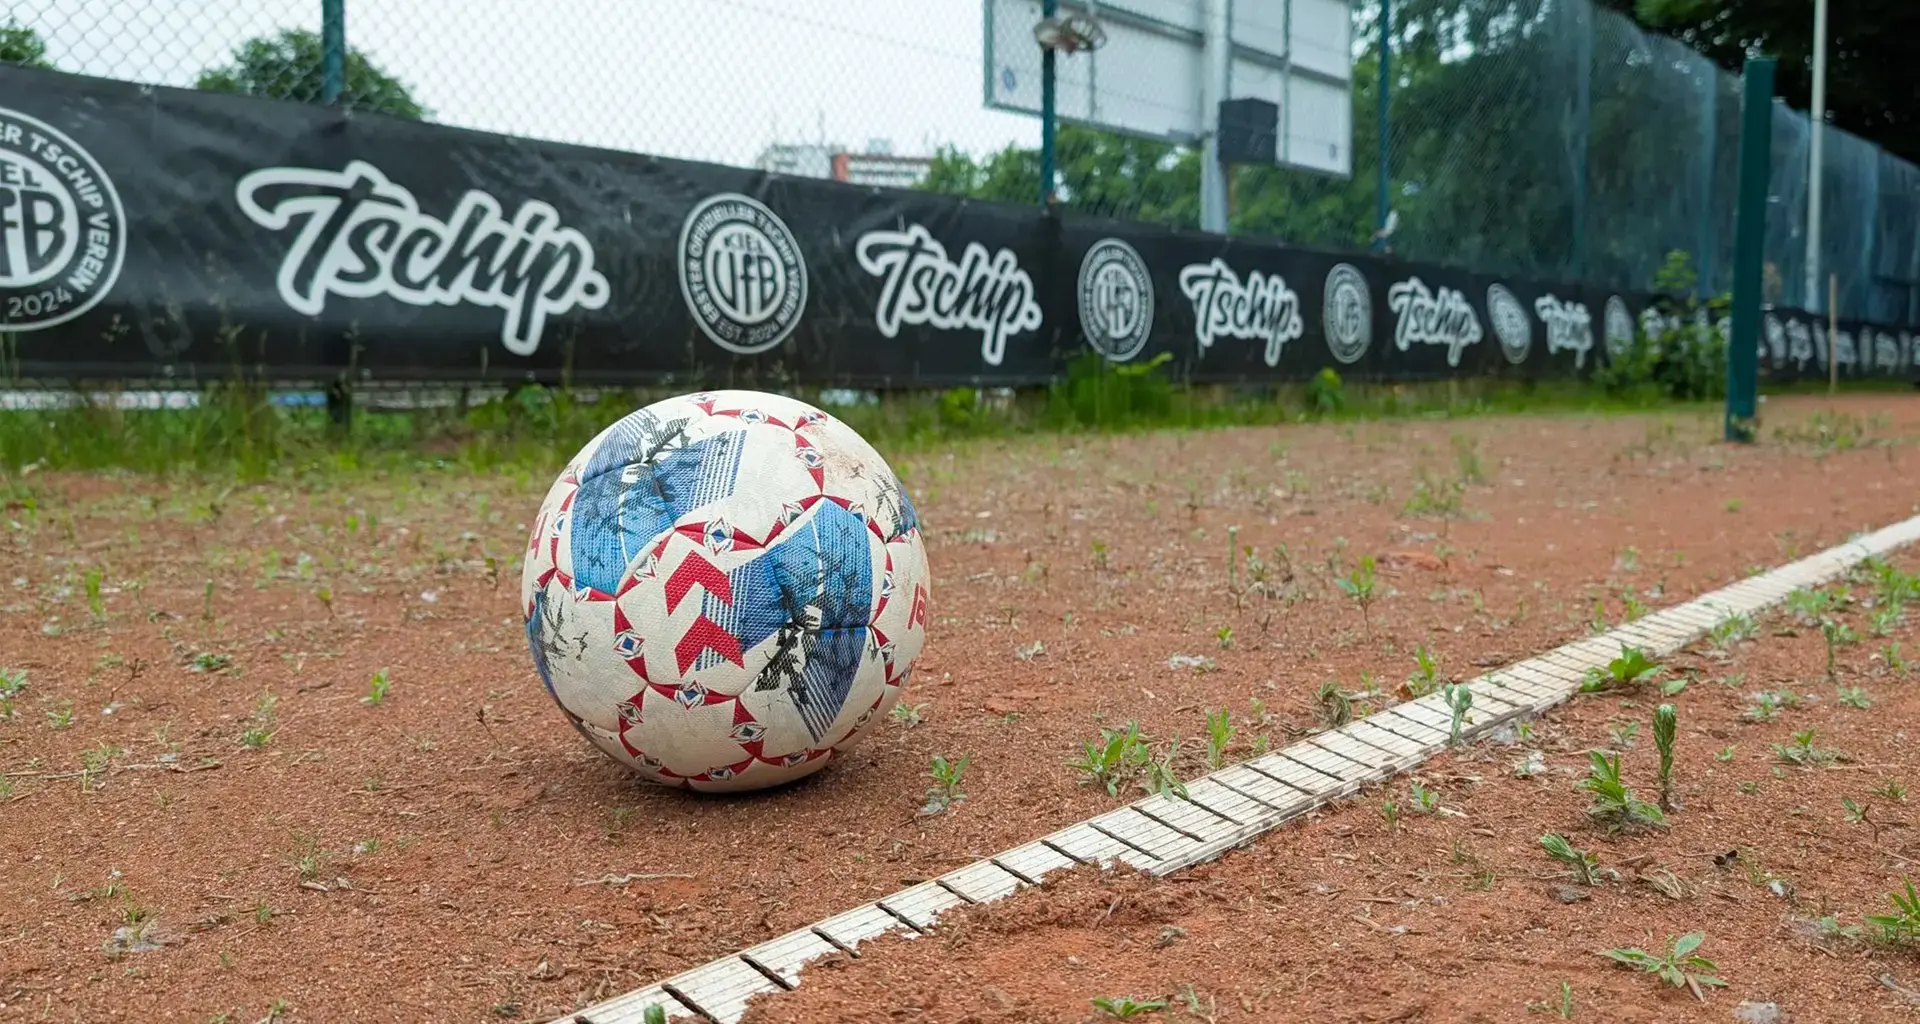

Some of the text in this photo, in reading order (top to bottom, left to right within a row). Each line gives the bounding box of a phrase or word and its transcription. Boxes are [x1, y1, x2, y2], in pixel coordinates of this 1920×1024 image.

[0, 159, 43, 188] EL
[29, 131, 111, 293] TSCHIP VEREIN
[0, 186, 67, 278] fB
[724, 232, 765, 254] KIEL
[8, 287, 72, 317] 2024
